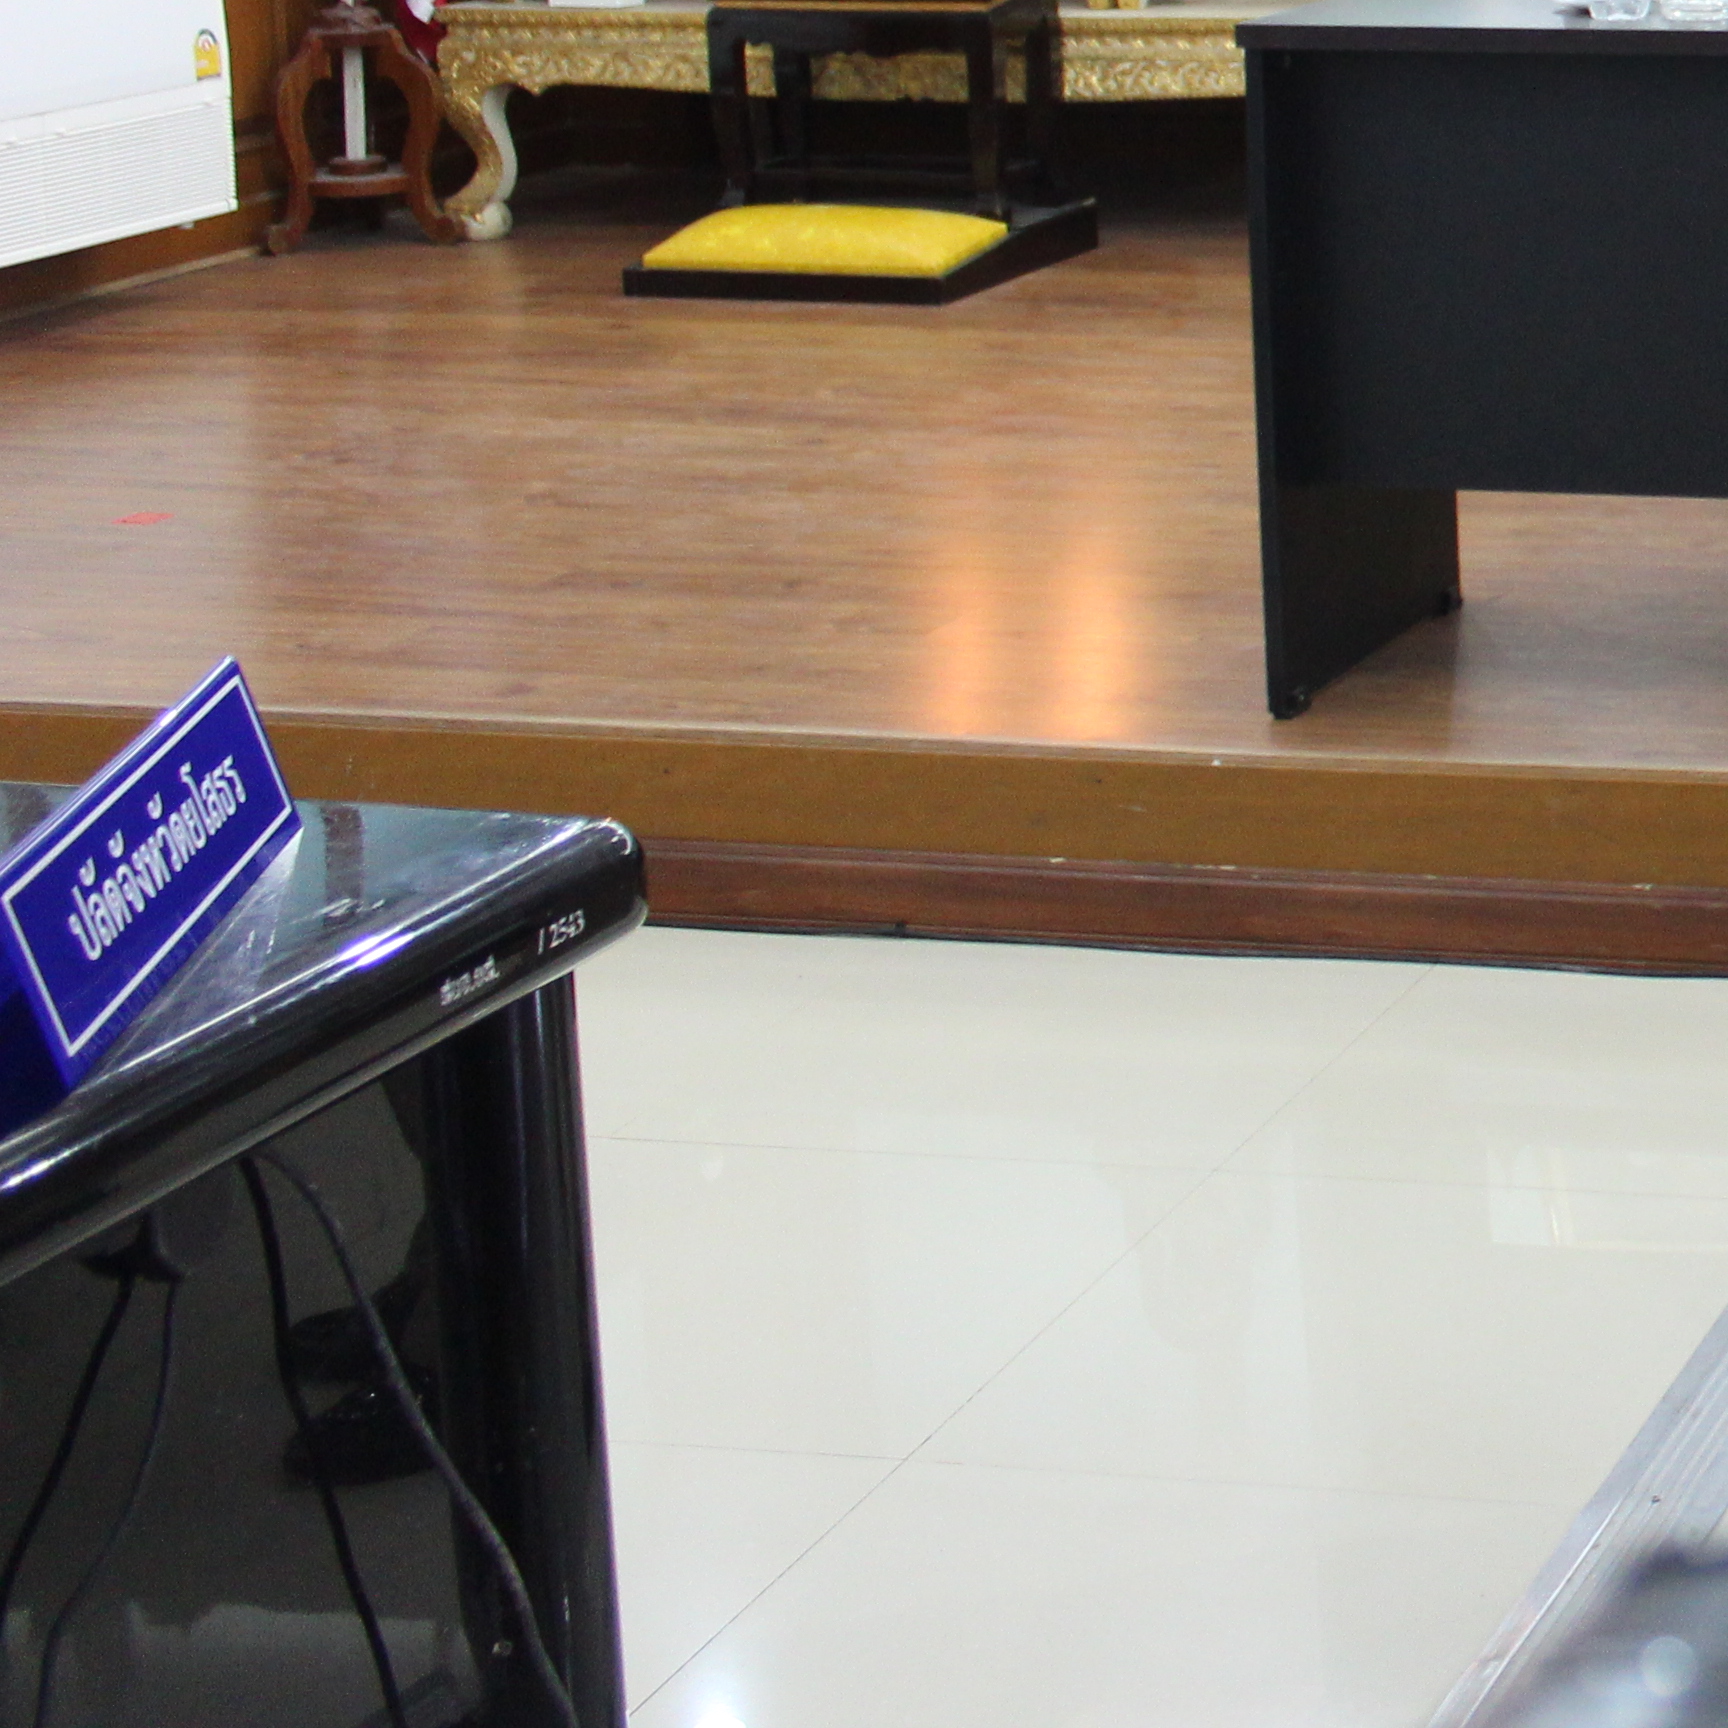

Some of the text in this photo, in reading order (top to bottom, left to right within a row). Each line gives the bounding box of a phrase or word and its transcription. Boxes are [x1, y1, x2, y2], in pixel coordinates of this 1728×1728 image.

[68, 754, 247, 961] ปลัดจังหวัดยโสธร
